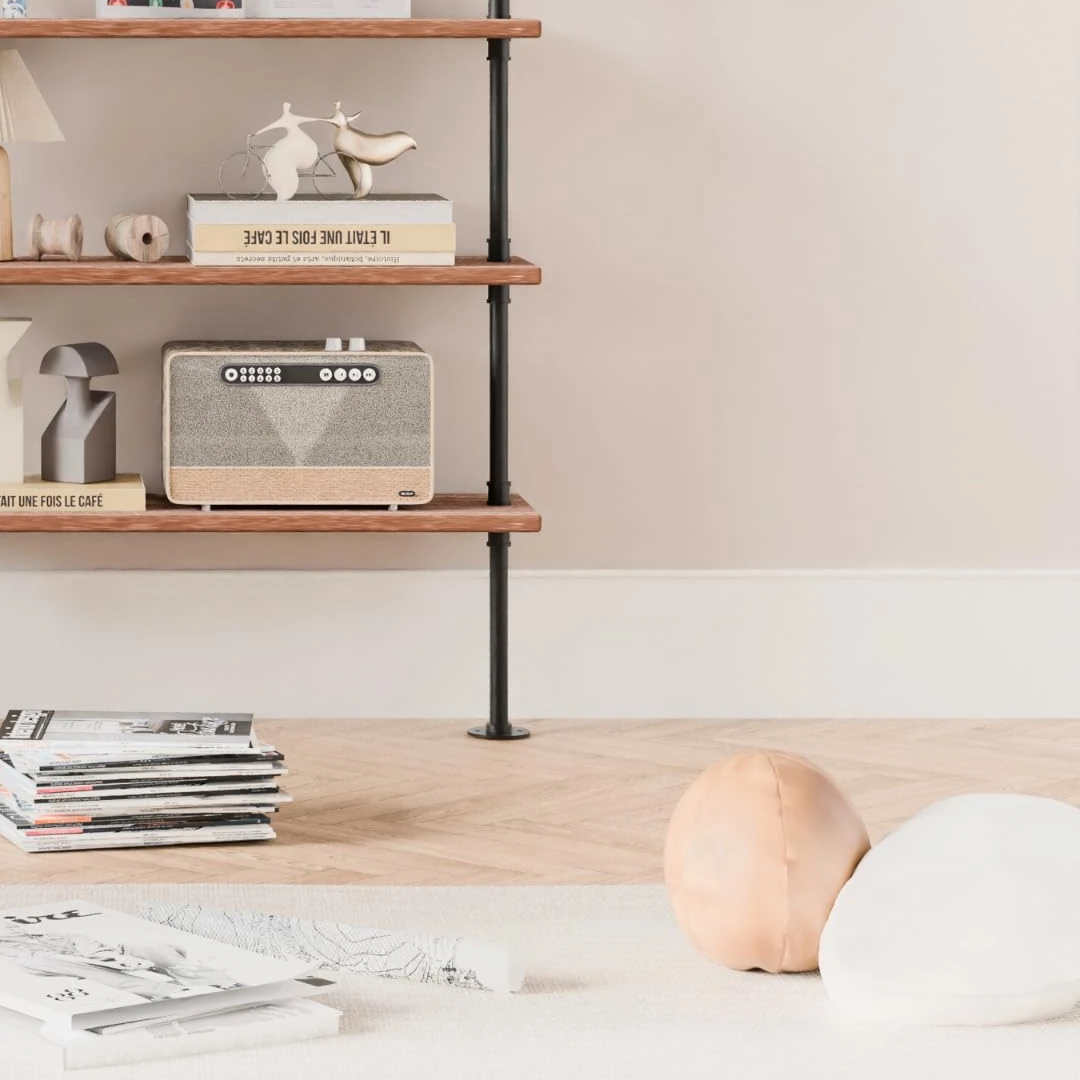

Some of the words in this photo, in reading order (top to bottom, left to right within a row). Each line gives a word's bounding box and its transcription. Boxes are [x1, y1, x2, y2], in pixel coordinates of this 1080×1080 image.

[243, 230, 272, 248] CAFÉ
[275, 230, 289, 245] LE
[292, 230, 317, 245] FOIS
[320, 230, 343, 245] UNE
[345, 230, 377, 248] ÉTAIT
[380, 230, 391, 245] IL
[18, 496, 38, 507] UNE
[40, 496, 62, 507] FOIS
[64, 496, 76, 507] LE
[78, 492, 103, 508] CAFÉ
